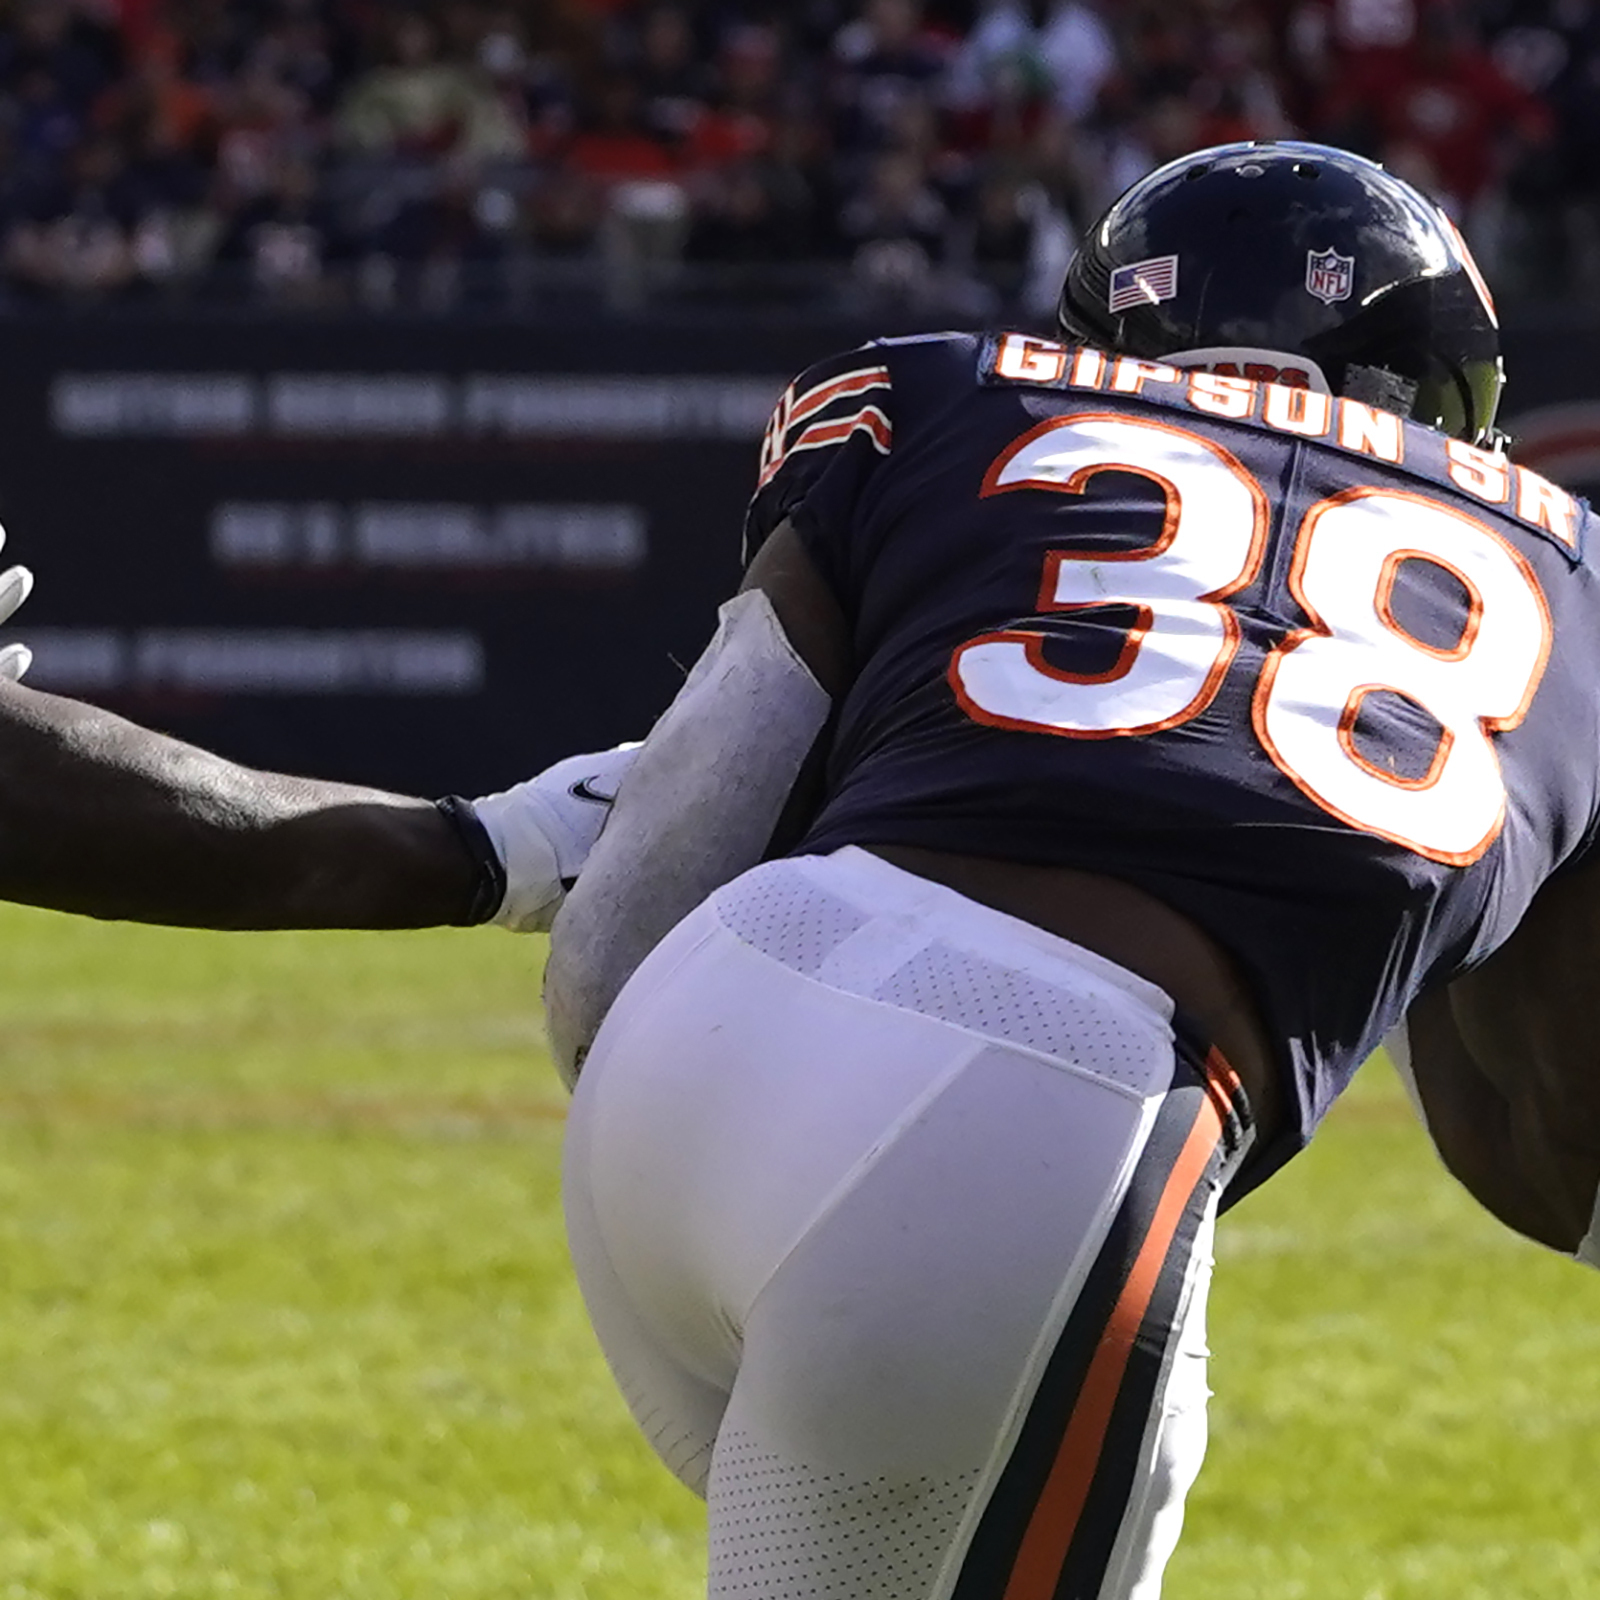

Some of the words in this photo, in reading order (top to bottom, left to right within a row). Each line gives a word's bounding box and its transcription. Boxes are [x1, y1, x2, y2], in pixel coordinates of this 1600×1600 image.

[1312, 270, 1346, 294] NFL
[995, 332, 1404, 465] GIPSON
[1446, 438, 1578, 548] SR
[948, 410, 1554, 867] 38
